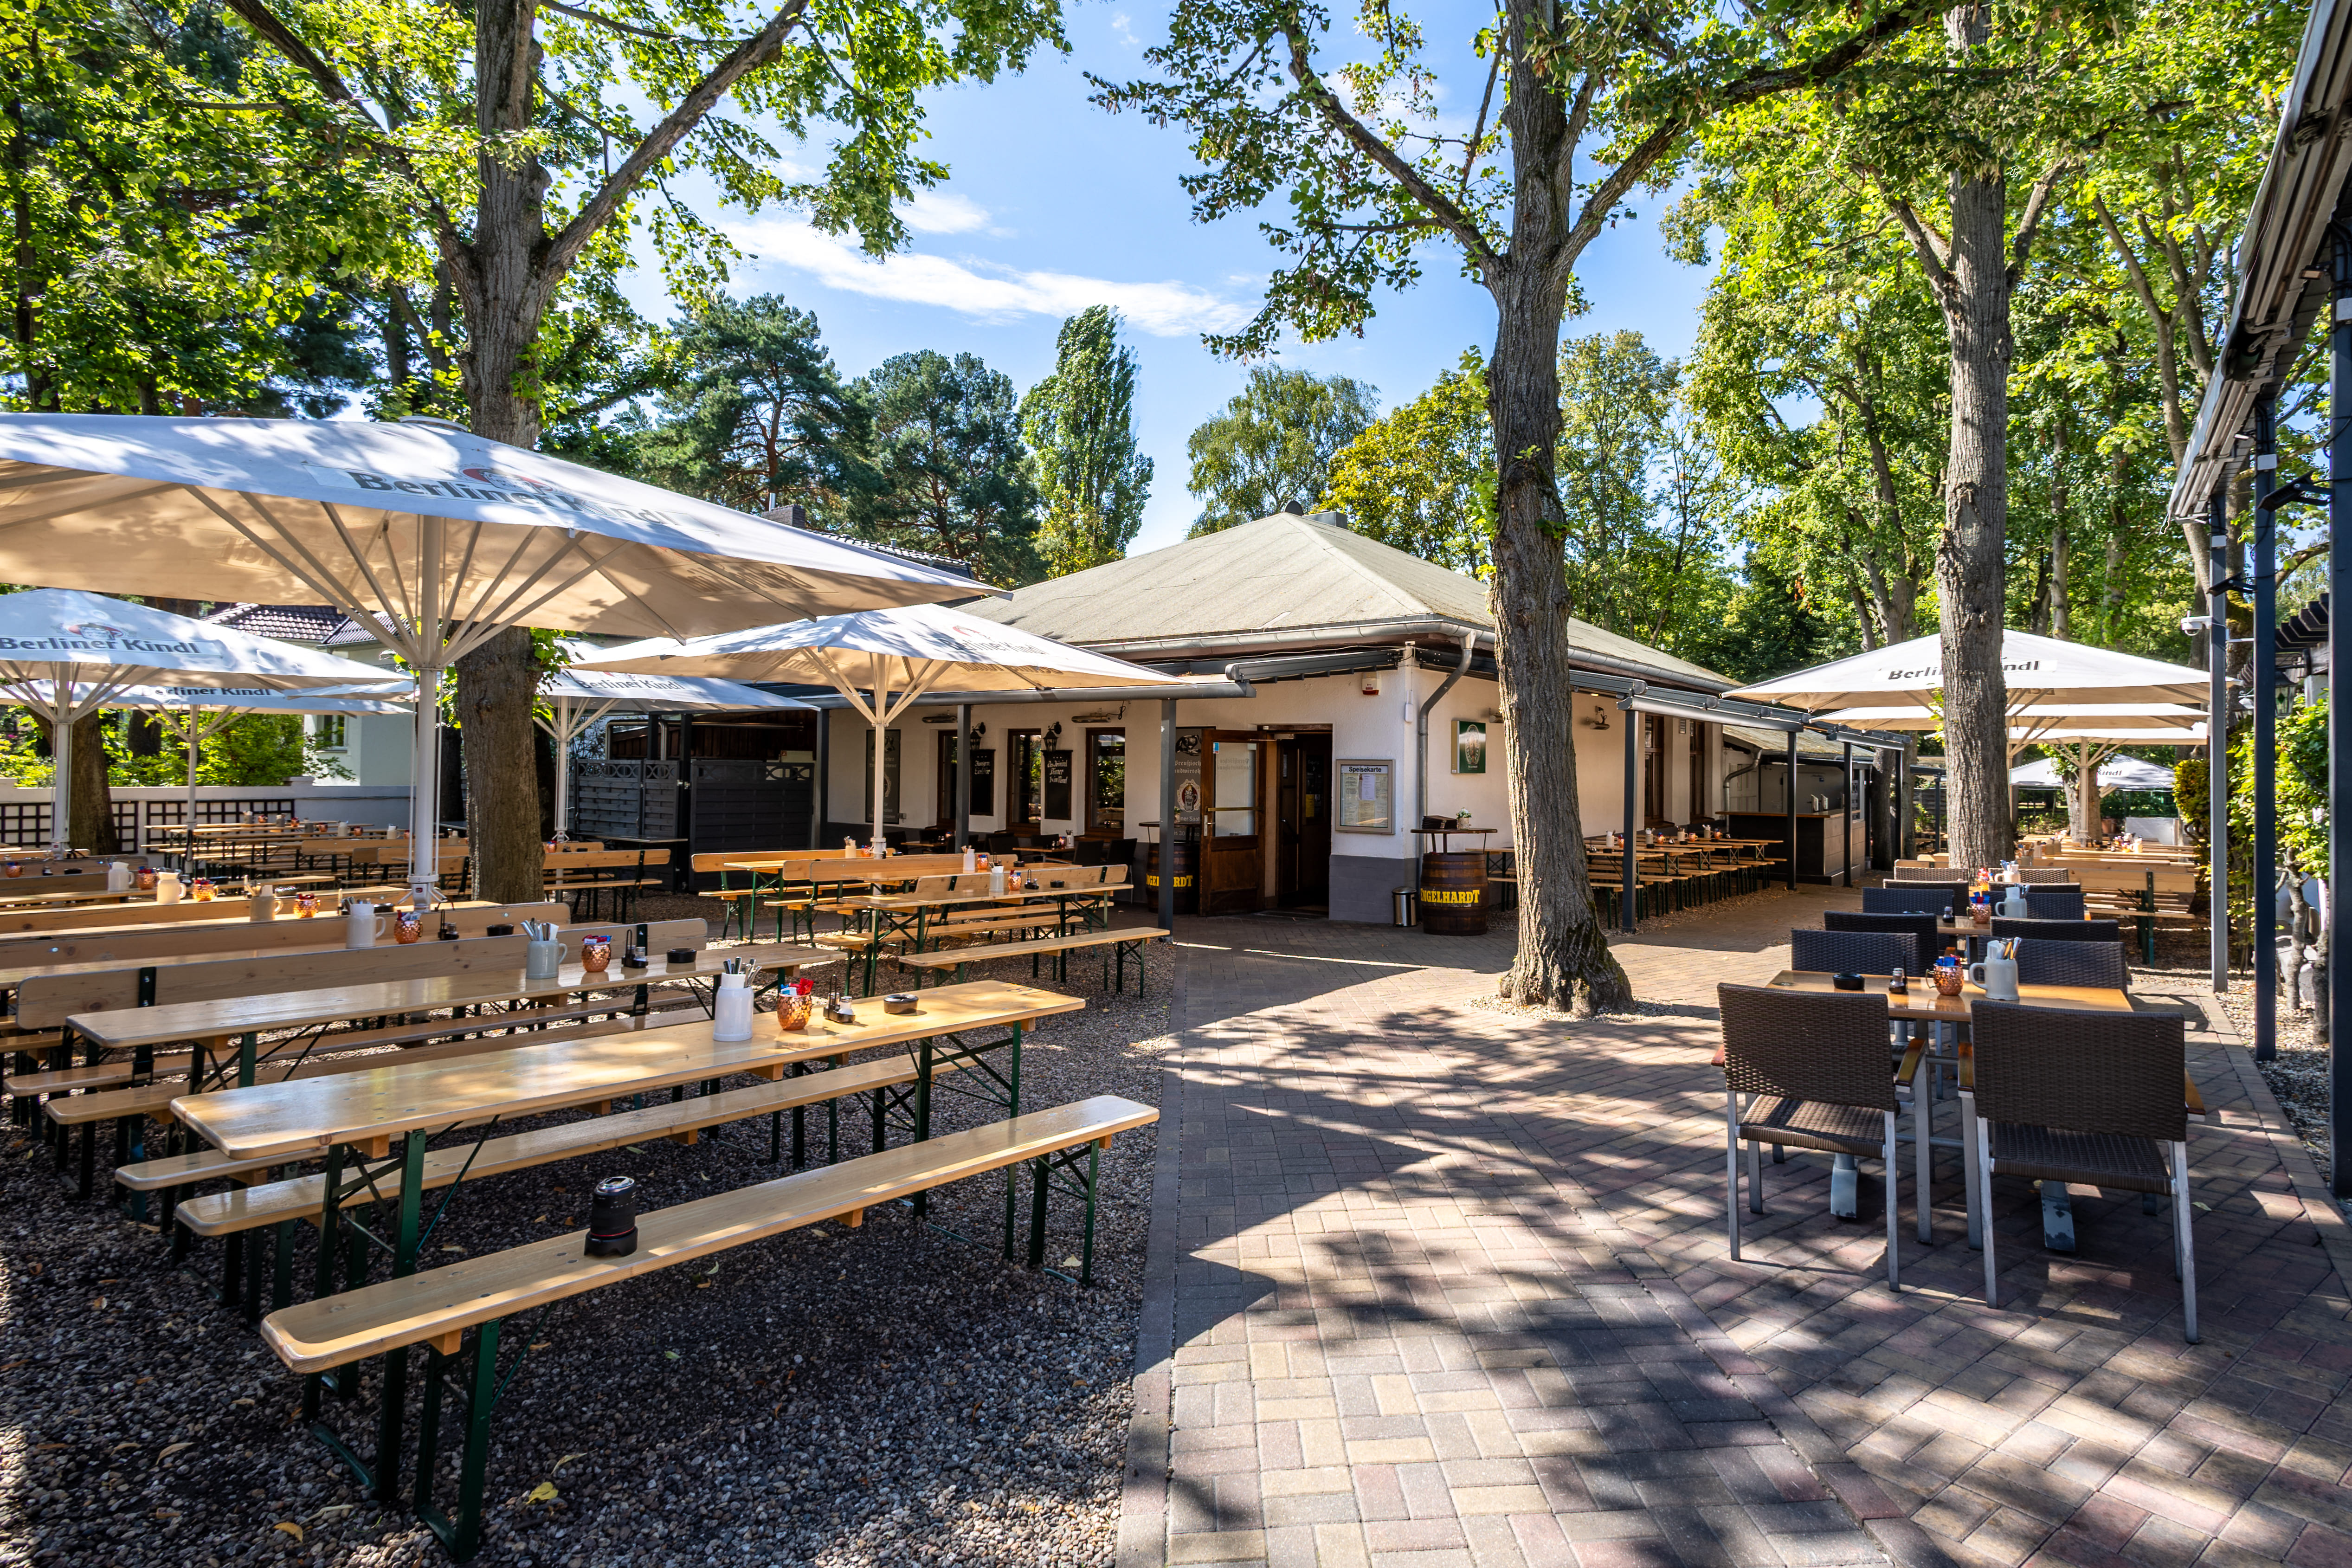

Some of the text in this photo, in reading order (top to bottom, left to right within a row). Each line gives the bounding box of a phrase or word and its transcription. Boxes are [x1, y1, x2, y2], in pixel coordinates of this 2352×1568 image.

[348, 472, 681, 526] Berliner Kindl
[0, 638, 201, 653] Berliner Kindl
[1888, 661, 2040, 680] Berli ndl
[575, 679, 686, 690] Berliner Kindl
[1421, 888, 1480, 903] ENGELHARDT
